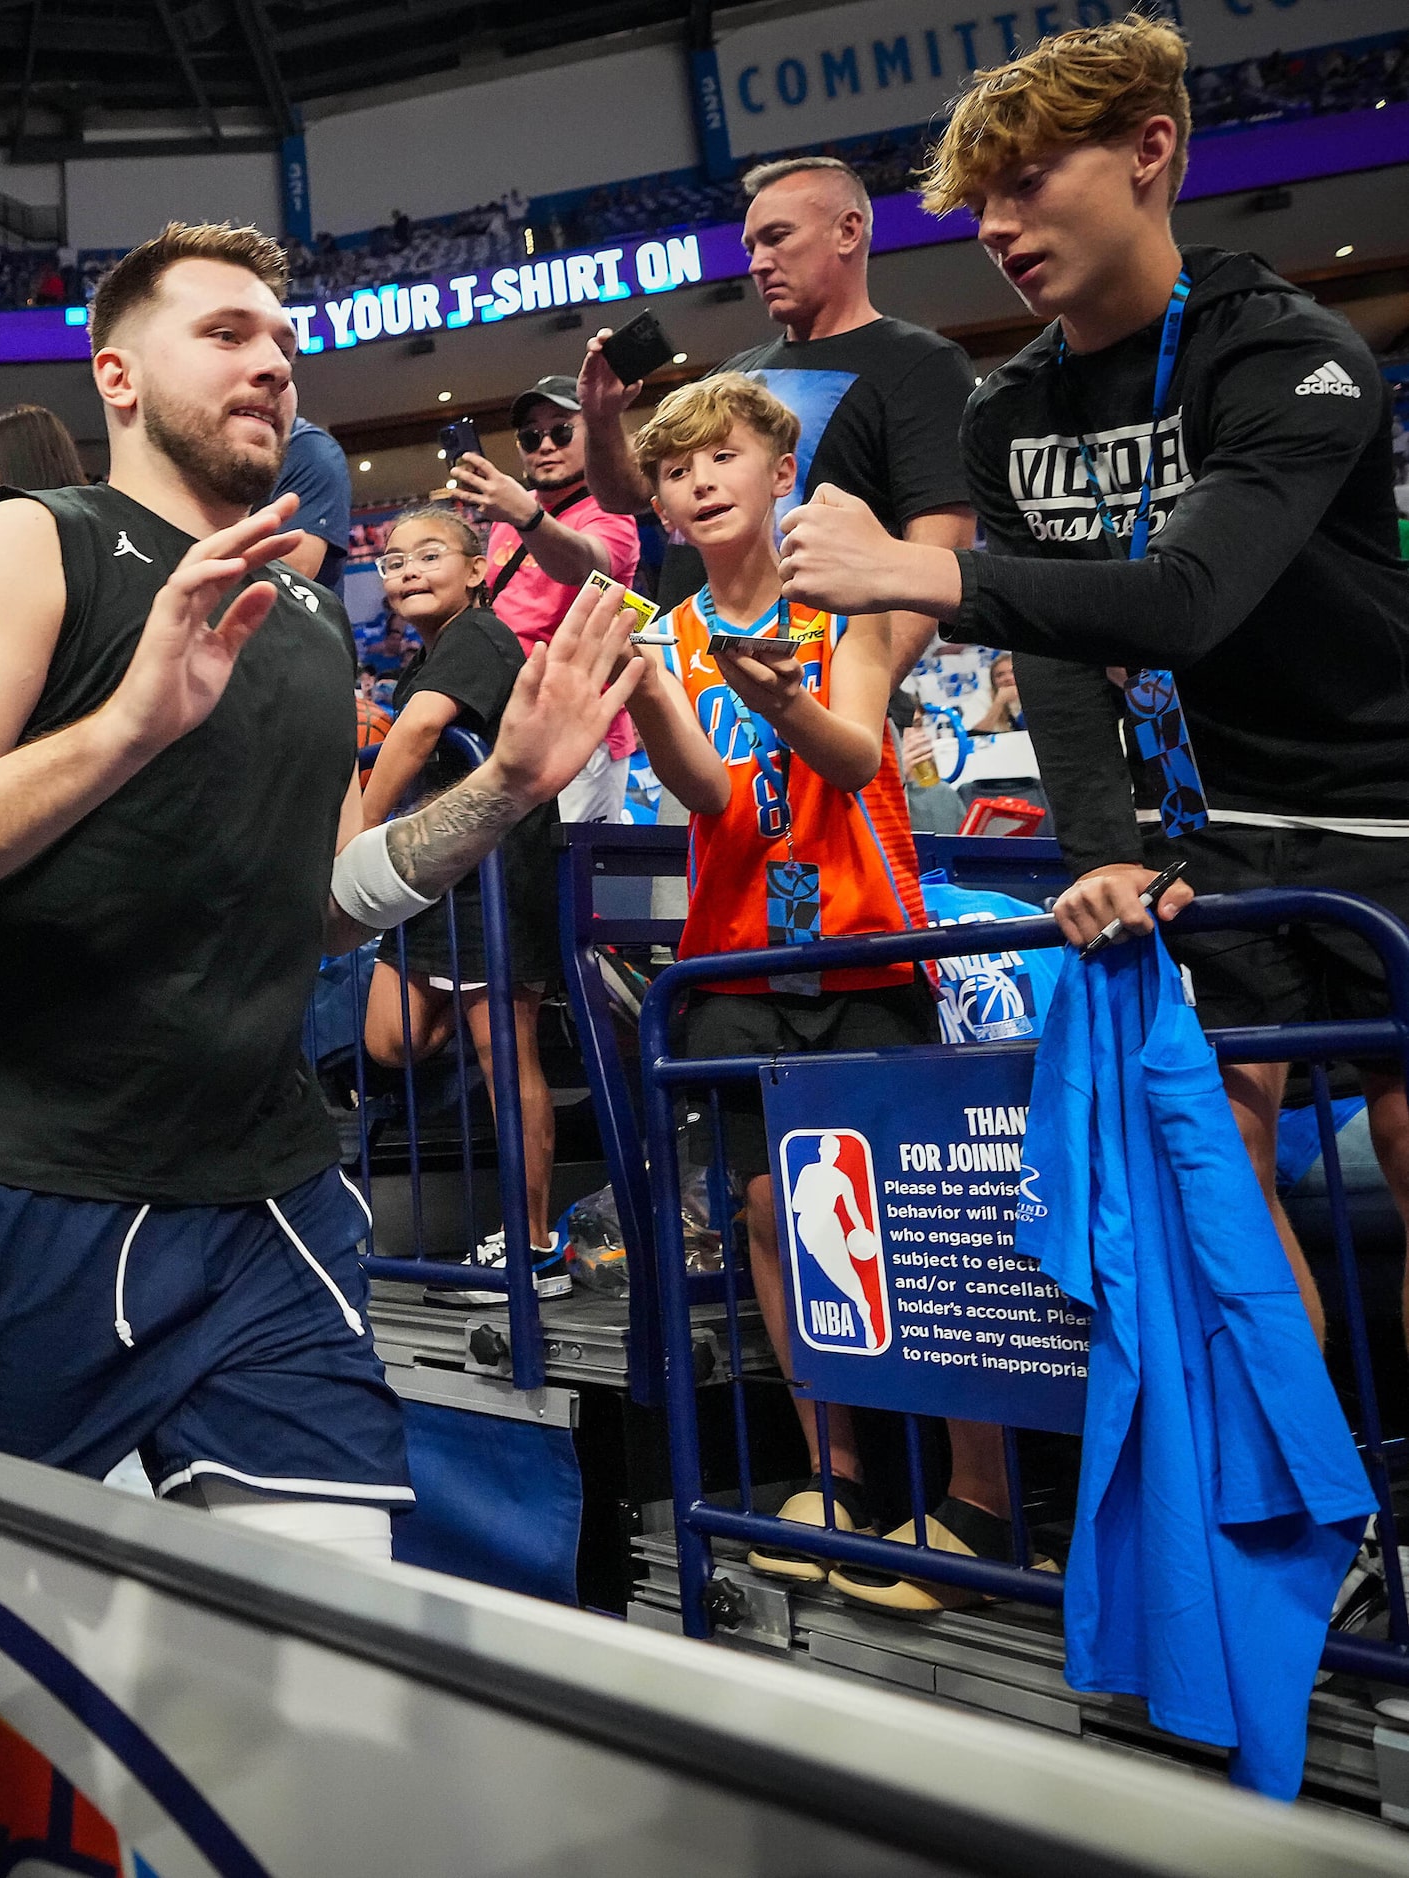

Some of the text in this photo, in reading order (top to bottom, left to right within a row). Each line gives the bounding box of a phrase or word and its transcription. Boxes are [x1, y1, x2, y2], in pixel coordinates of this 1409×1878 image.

[325, 284, 441, 345] YOUR
[450, 249, 623, 323] T-SHIRT
[636, 235, 702, 290] ON
[1294, 381, 1362, 399] adidas
[964, 1107, 1030, 1136] THAN
[899, 1143, 1023, 1172] FOR JOININ
[884, 1180, 937, 1196] Please
[941, 1181, 964, 1196] be
[887, 1204, 961, 1220] behavior
[966, 1206, 997, 1221] will
[890, 1228, 1014, 1246] who engage in
[892, 1252, 959, 1269] subject
[962, 1254, 982, 1269] to
[895, 1275, 957, 1293] and/or
[810, 1300, 856, 1337] NBA
[965, 1306, 1042, 1323] account.
[900, 1324, 1090, 1352] you have any questions
[902, 1346, 1091, 1378] to report inappropria
